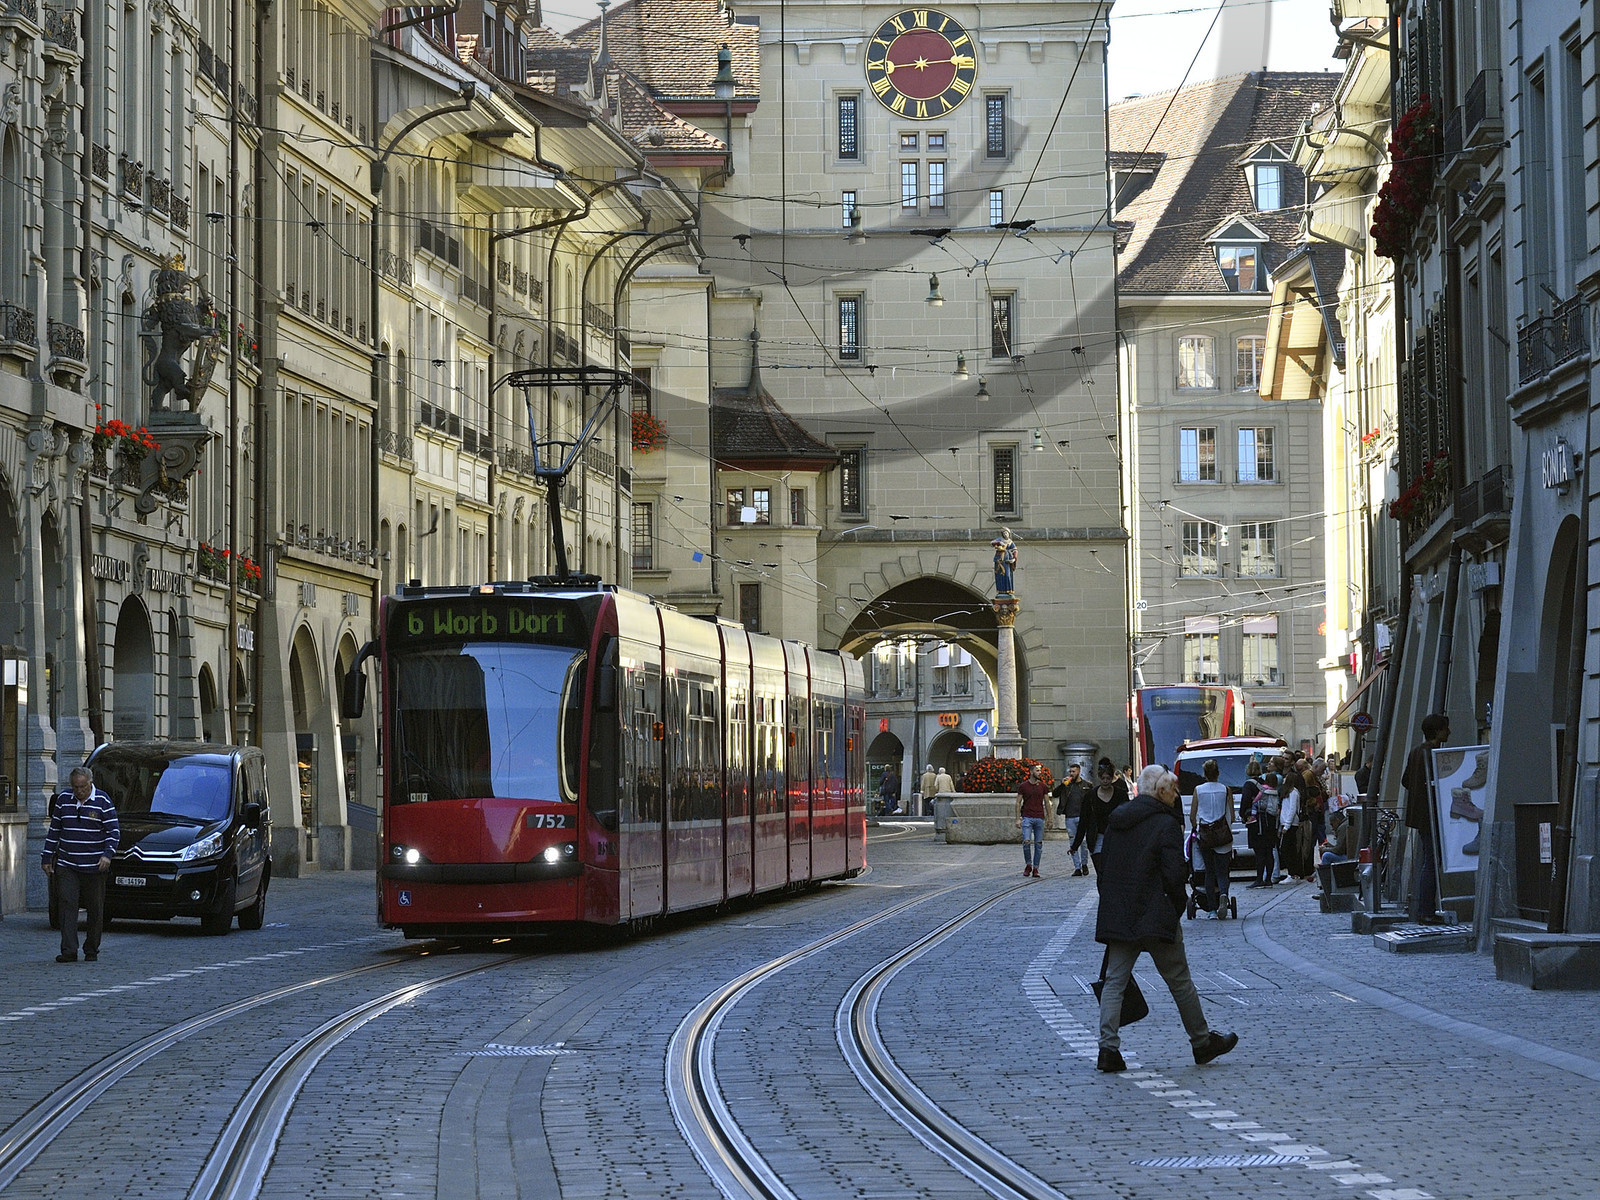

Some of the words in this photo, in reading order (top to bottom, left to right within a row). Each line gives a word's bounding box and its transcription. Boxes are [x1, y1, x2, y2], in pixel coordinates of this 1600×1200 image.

[913, 11, 928, 28] XII
[1542, 445, 1568, 489] BONITA
[151, 569, 172, 592] BAYARD
[408, 610, 424, 635] 6
[434, 607, 498, 635] Worb
[508, 607, 567, 634] Dort
[938, 713, 959, 728] coop
[535, 814, 566, 829] 752
